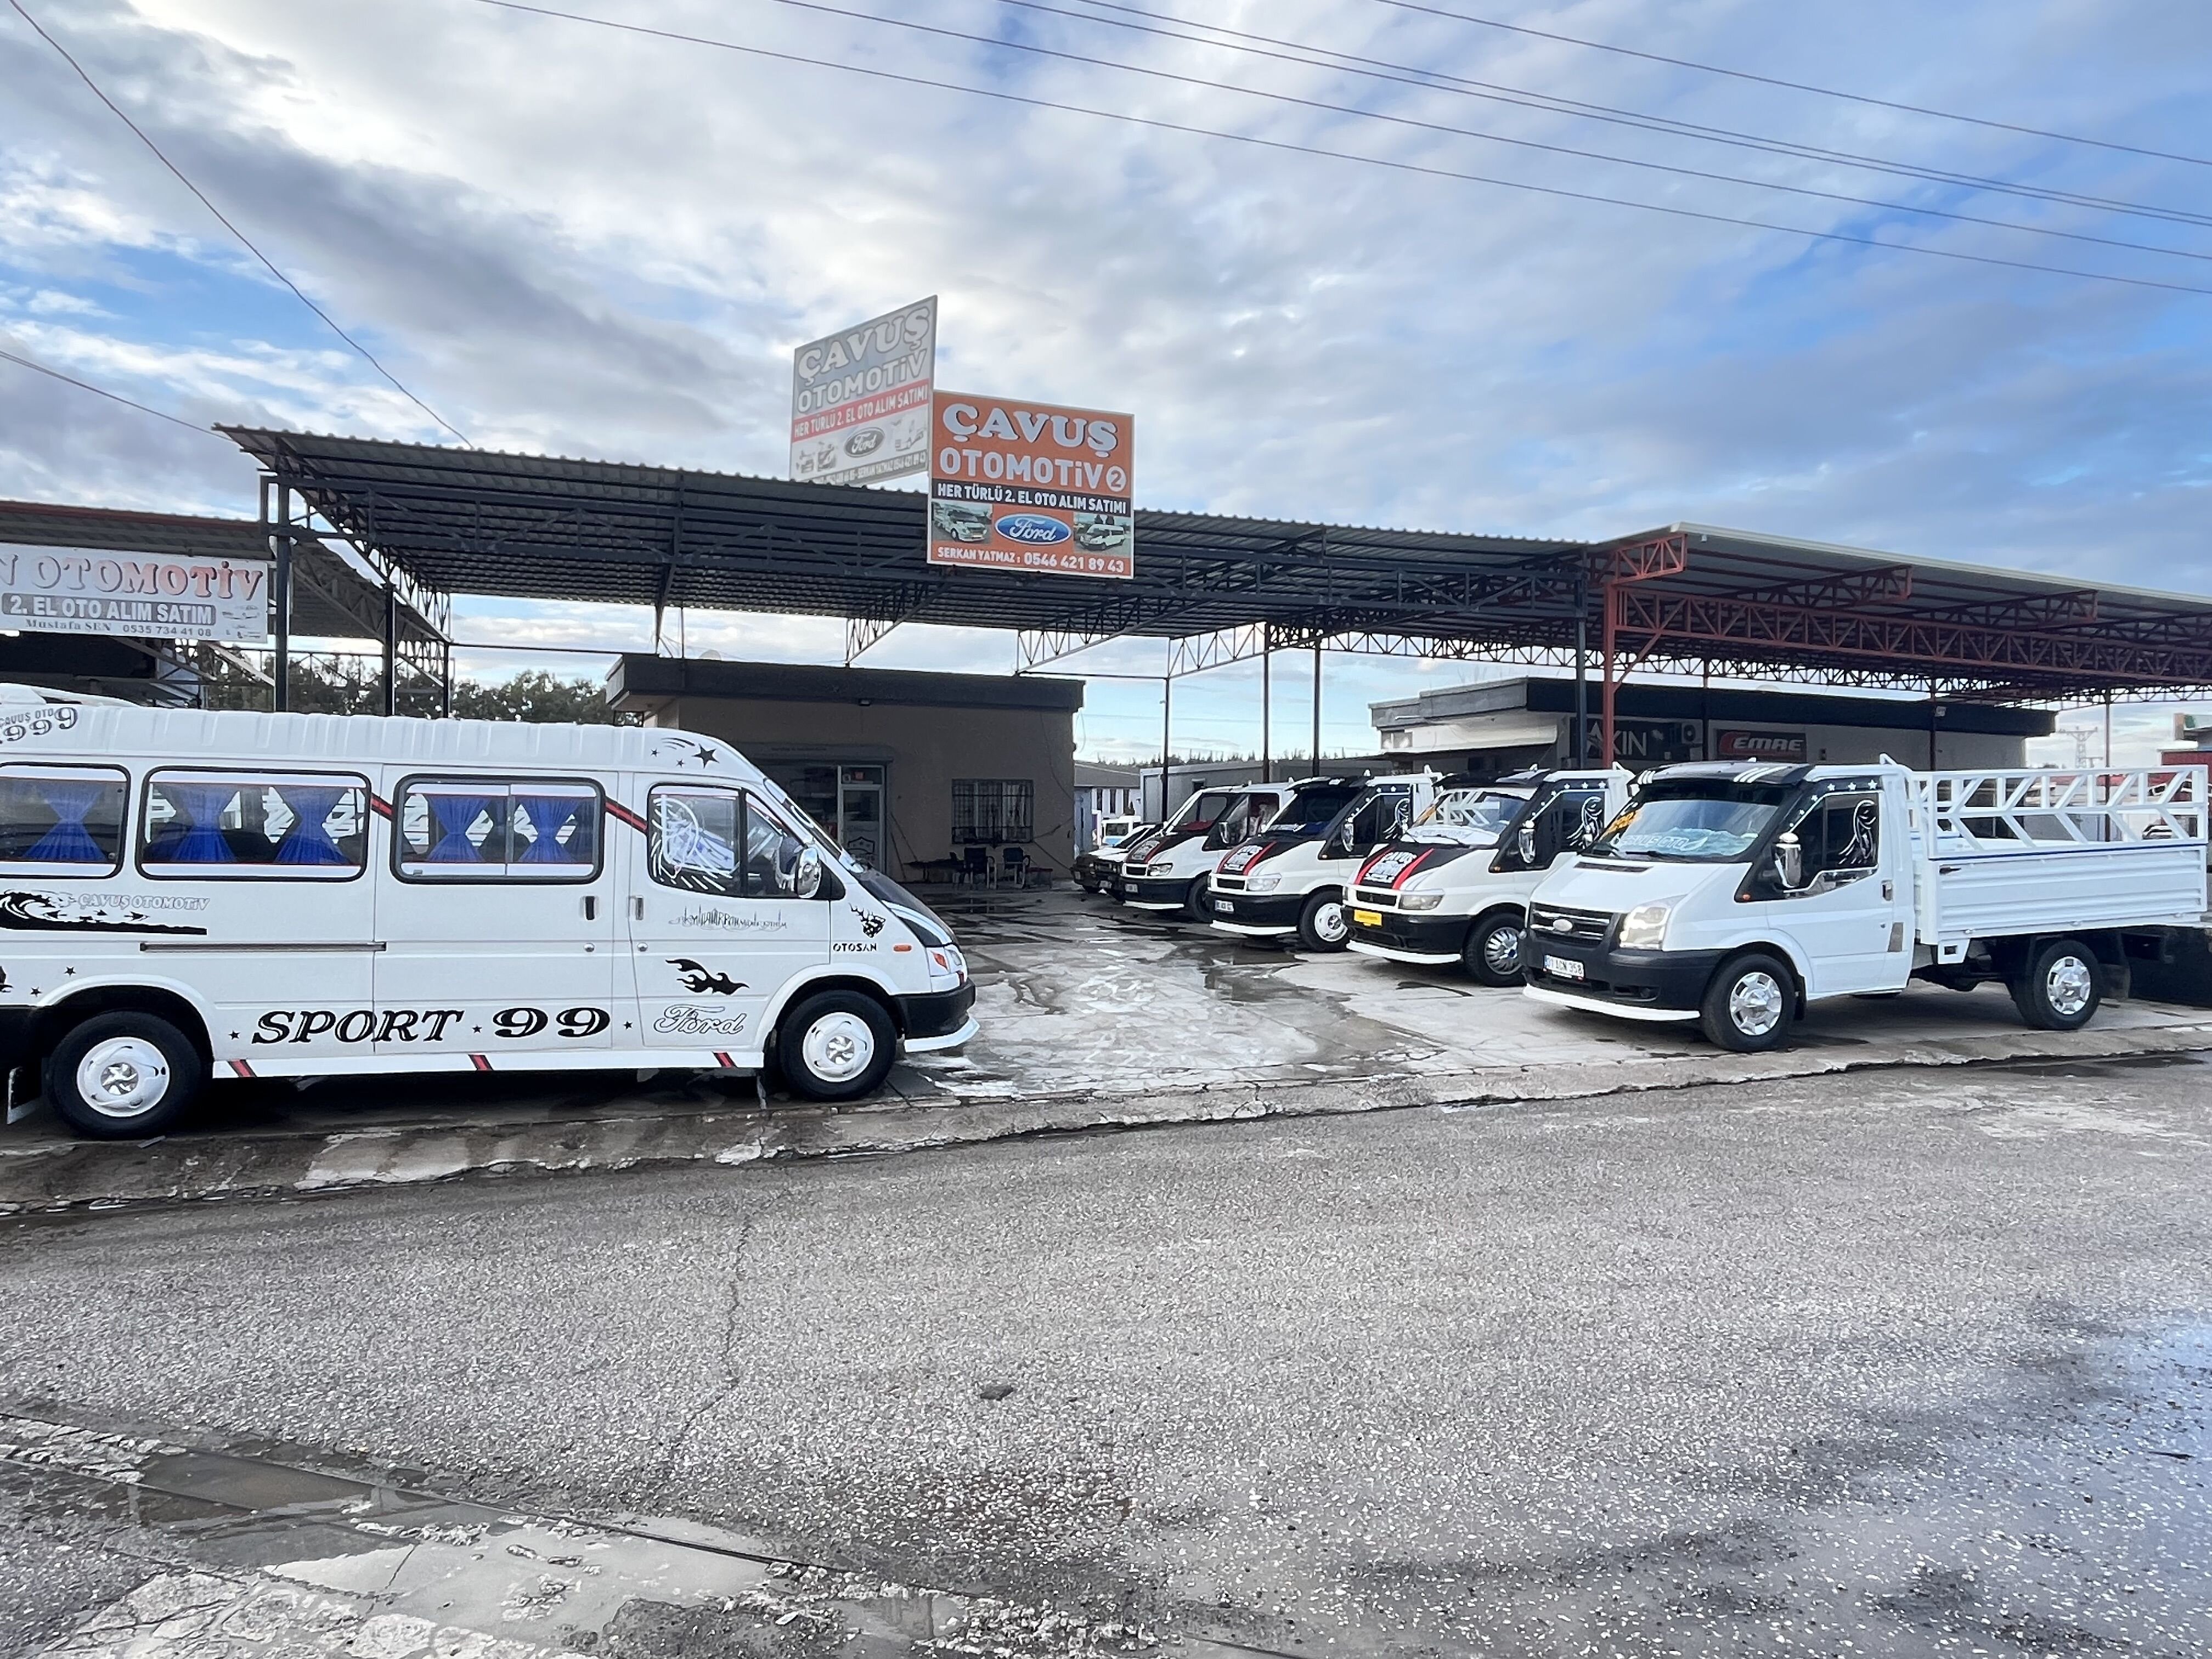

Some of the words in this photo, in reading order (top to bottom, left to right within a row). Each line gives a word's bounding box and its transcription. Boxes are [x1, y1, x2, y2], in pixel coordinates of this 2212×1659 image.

[798, 307, 930, 387] ÇAVUŞ
[795, 422, 809, 437] HER
[845, 410, 856, 423] EL
[857, 404, 873, 420] OTO
[874, 395, 896, 415] ALIM
[898, 385, 928, 408] SATIMI
[851, 432, 877, 454] Ford
[943, 403, 1118, 458] ÇAVUŞ
[938, 483, 962, 498] HER
[964, 483, 1003, 501] TÜRLÜ
[1006, 489, 1015, 504] 2.
[1018, 490, 1032, 505] EL
[1035, 492, 1057, 506] OTO
[1059, 494, 1086, 510] ALIM
[1088, 498, 1126, 514] SATIMI
[1009, 518, 1056, 541] Ford
[938, 546, 976, 560] SERKAN
[978, 549, 1015, 563] YATMAZ
[1024, 552, 1057, 567] 0546
[1060, 555, 1084, 569] 421
[1088, 556, 1105, 572] 89
[1107, 559, 1124, 573] 43
[10, 594, 27, 614] 2.
[33, 596, 57, 616] EL
[62, 597, 102, 619] OTO
[106, 600, 152, 622] ALIM
[157, 604, 212, 625] SATIM
[26, 619, 81, 630] Mustafa
[123, 624, 152, 634] 0535
[155, 625, 177, 635] 734
[180, 627, 193, 636] 41
[198, 628, 212, 637] 08
[0, 707, 78, 744] 999
[35, 708, 54, 719] OTO
[78, 893, 131, 911] ÇAVUŞ
[833, 943, 877, 952] OTOSAN
[251, 1009, 465, 1044] SPORT
[492, 1007, 611, 1039] 99
[653, 1003, 747, 1035] Ford
